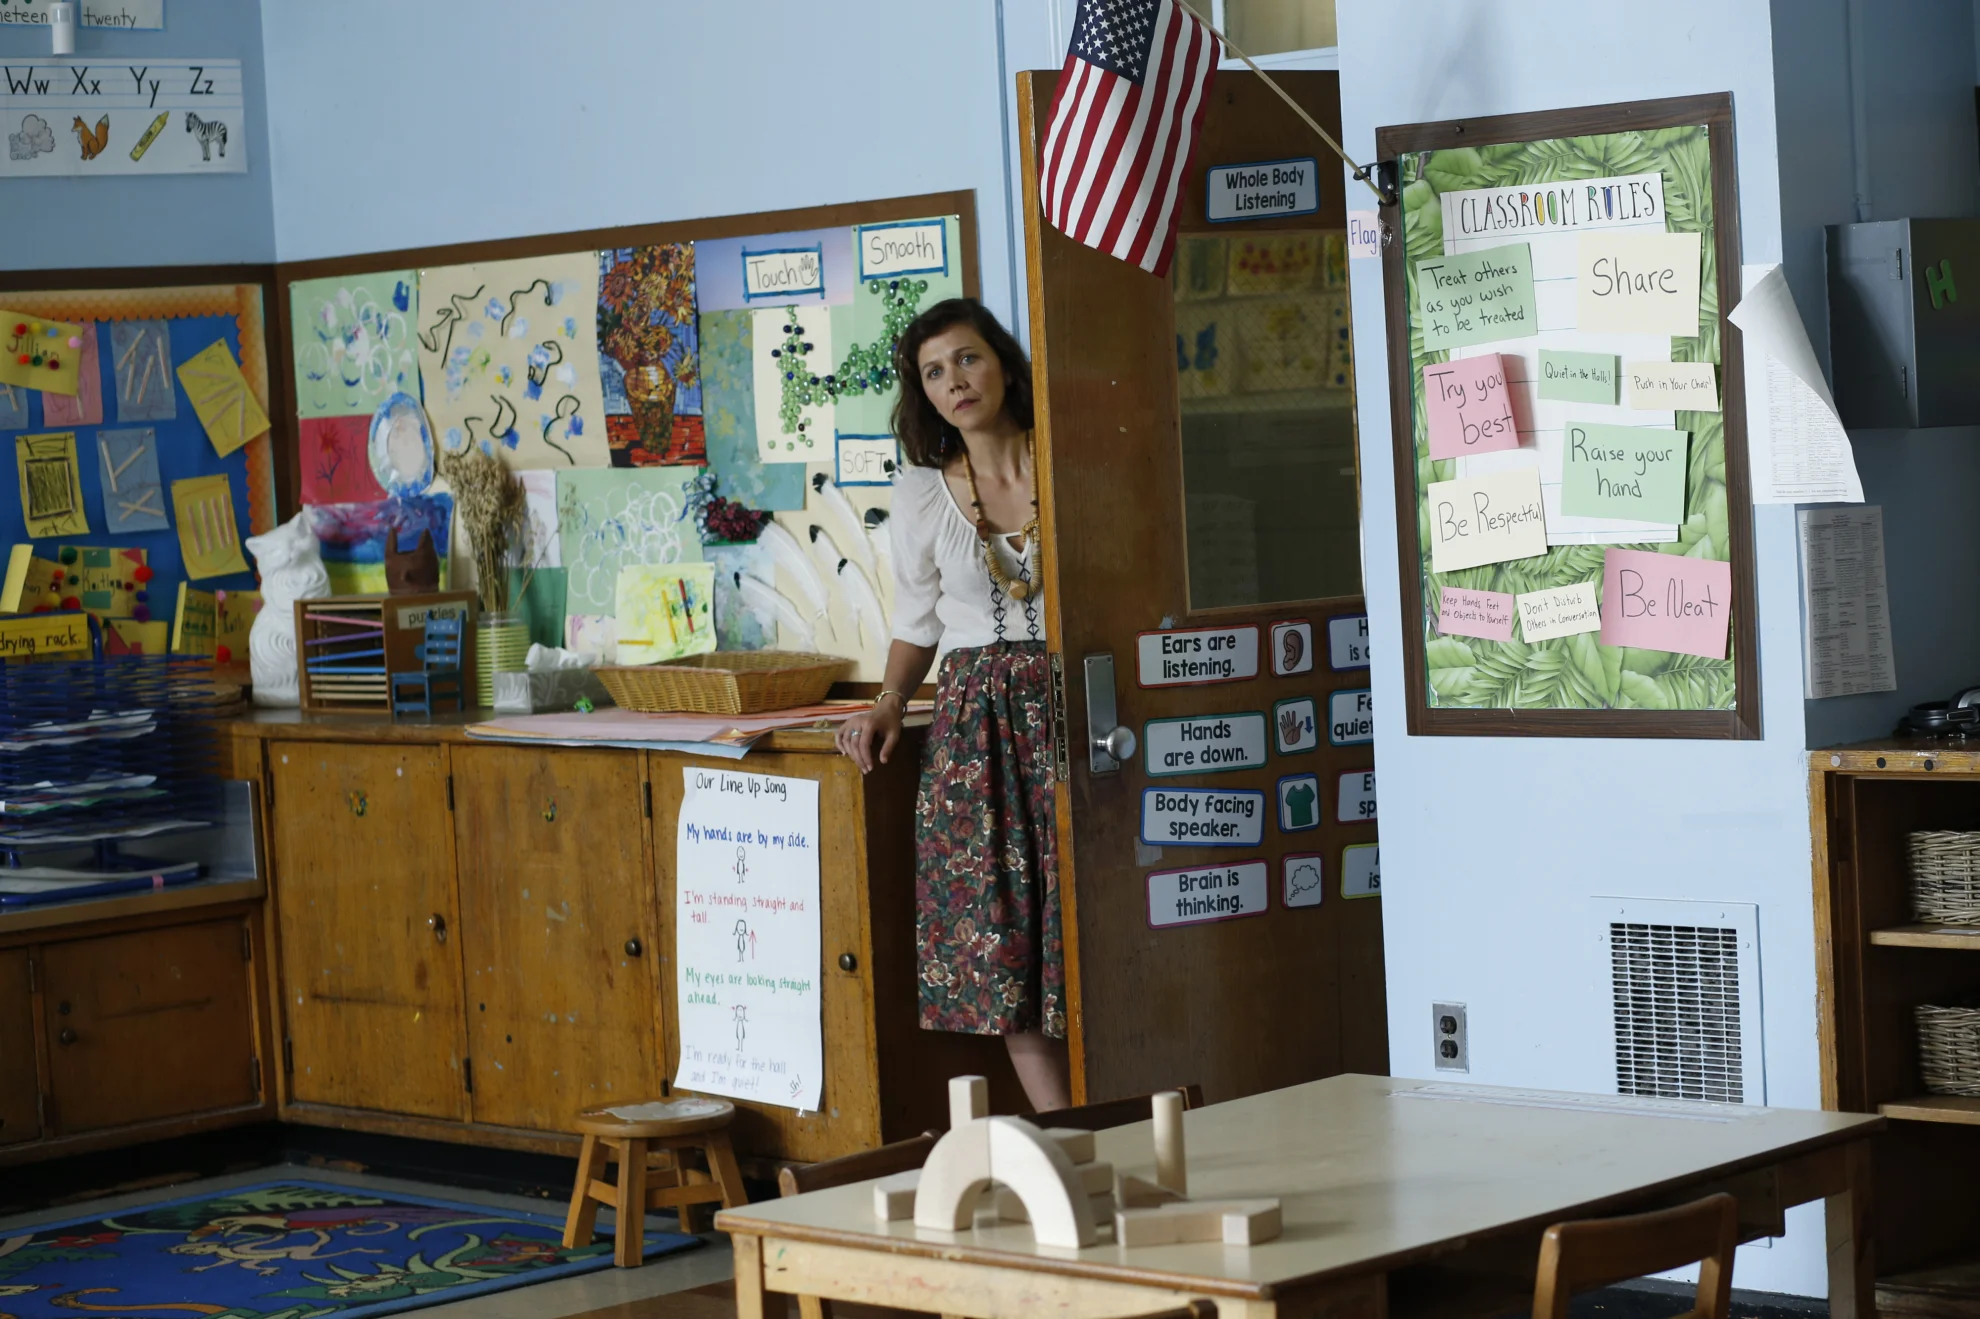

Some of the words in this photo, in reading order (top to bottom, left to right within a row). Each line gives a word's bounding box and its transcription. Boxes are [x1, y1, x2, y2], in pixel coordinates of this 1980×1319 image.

[83, 7, 137, 30] twenty
[5, 66, 50, 95] Ww
[71, 66, 101, 95] Xx
[130, 66, 160, 108] Yy
[189, 66, 214, 95] Zz
[1226, 170, 1268, 189] Whole
[1272, 166, 1304, 186] Body
[1235, 190, 1296, 211] Listening
[1461, 187, 1578, 234] CLASSROOM
[1586, 181, 1656, 222] RULES
[870, 231, 935, 264] Smooth
[1351, 219, 1377, 255] Flag
[750, 259, 797, 289] Touch
[1421, 264, 1466, 289] Treat
[1475, 261, 1518, 283] others
[1592, 257, 1677, 296] Share
[1925, 259, 1957, 310] H
[1427, 299, 1443, 314] as
[1450, 294, 1473, 316] you
[1479, 284, 1514, 302] wish
[1432, 320, 1450, 335] to
[1456, 314, 1471, 332] be
[1479, 305, 1525, 325] treated
[1545, 361, 1568, 379] Quiet
[1570, 370, 1577, 379] in
[1579, 367, 1588, 379] the
[1591, 367, 1611, 386] Halls!
[1634, 376, 1654, 390] Push
[1659, 380, 1668, 390] in
[1669, 378, 1687, 390] Your
[1429, 371, 1466, 408] Try
[1475, 372, 1503, 401] you
[1459, 403, 1512, 445] best
[843, 450, 887, 474] SOFT
[1571, 428, 1624, 462] Raise
[1635, 449, 1673, 476] your
[1596, 468, 1642, 498] hand
[1438, 501, 1468, 543] Be
[1473, 491, 1543, 536] Respectful
[1442, 592, 1457, 606] Keep
[1486, 599, 1499, 610] Feet
[1524, 598, 1548, 615] Don't
[1553, 593, 1582, 607] Disturb
[1620, 569, 1656, 618] Be
[1666, 578, 1718, 618] Neat
[1454, 610, 1476, 621] Objects
[1479, 613, 1485, 621] to
[1527, 618, 1547, 632] Others
[1558, 610, 1597, 625] Conversation
[1162, 634, 1201, 654] Ears
[1207, 633, 1236, 650] are
[1349, 644, 1360, 661] is
[1163, 657, 1235, 679] listening.
[1180, 720, 1231, 742] Hands
[1164, 749, 1194, 767] are
[1200, 745, 1248, 764] down.
[696, 773, 714, 789] Our
[720, 773, 744, 794] Line
[748, 776, 760, 799] Up
[764, 777, 787, 802] Song
[1155, 793, 1199, 816] Body
[1205, 795, 1254, 818] facing
[686, 823, 699, 844] My
[703, 826, 732, 843] hands
[737, 831, 753, 844] are
[758, 829, 768, 848] by
[773, 834, 784, 850] my
[788, 832, 809, 848] side.
[1169, 819, 1240, 840] speaker.
[1179, 872, 1222, 893] Brain
[1227, 869, 1239, 887] is
[684, 890, 703, 905] I'm
[708, 892, 747, 912] standing
[753, 895, 785, 914] straight
[790, 899, 804, 911] and
[1176, 895, 1243, 918] thinking.
[686, 967, 701, 988] My
[705, 974, 724, 988] eyes
[728, 975, 742, 985] are
[747, 974, 776, 993] looking
[779, 978, 811, 996] straight
[688, 991, 720, 1006] ahead.
[685, 1045, 703, 1060] I'm
[708, 1051, 731, 1070] ready
[736, 1054, 746, 1068] for
[751, 1056, 765, 1072] the
[769, 1058, 786, 1075] hall
[691, 1071, 705, 1083] and
[711, 1071, 726, 1085] I'm
[732, 1076, 759, 1093] quiet!
